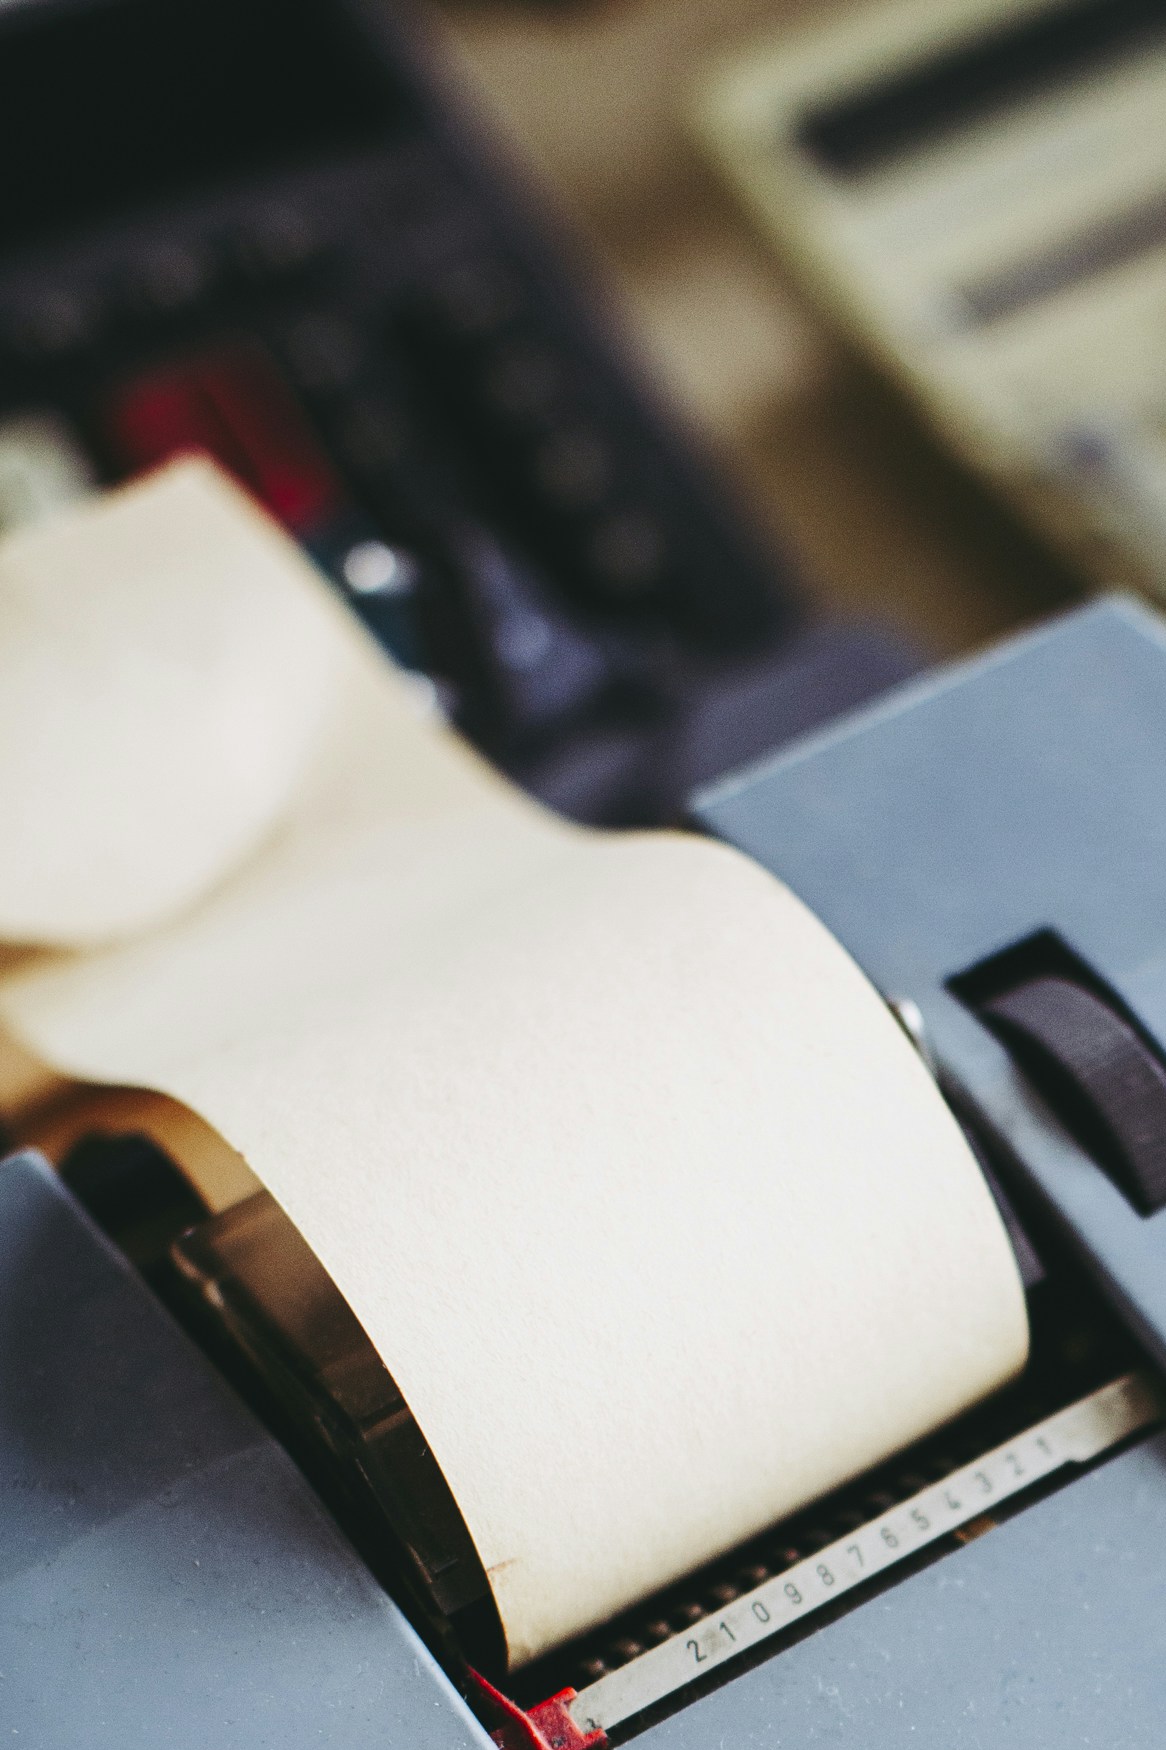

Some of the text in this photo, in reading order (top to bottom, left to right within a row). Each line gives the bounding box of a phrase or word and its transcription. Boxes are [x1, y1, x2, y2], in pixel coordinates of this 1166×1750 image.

[686, 1640, 707, 1663] 2
[719, 1622, 736, 1642] 1
[751, 1601, 770, 1623] 0
[783, 1583, 802, 1604] 9
[816, 1564, 835, 1586] 8
[847, 1544, 864, 1567] 7
[880, 1527, 899, 1548] 6
[911, 1507, 930, 1531] 5
[974, 1470, 993, 1494] 3
